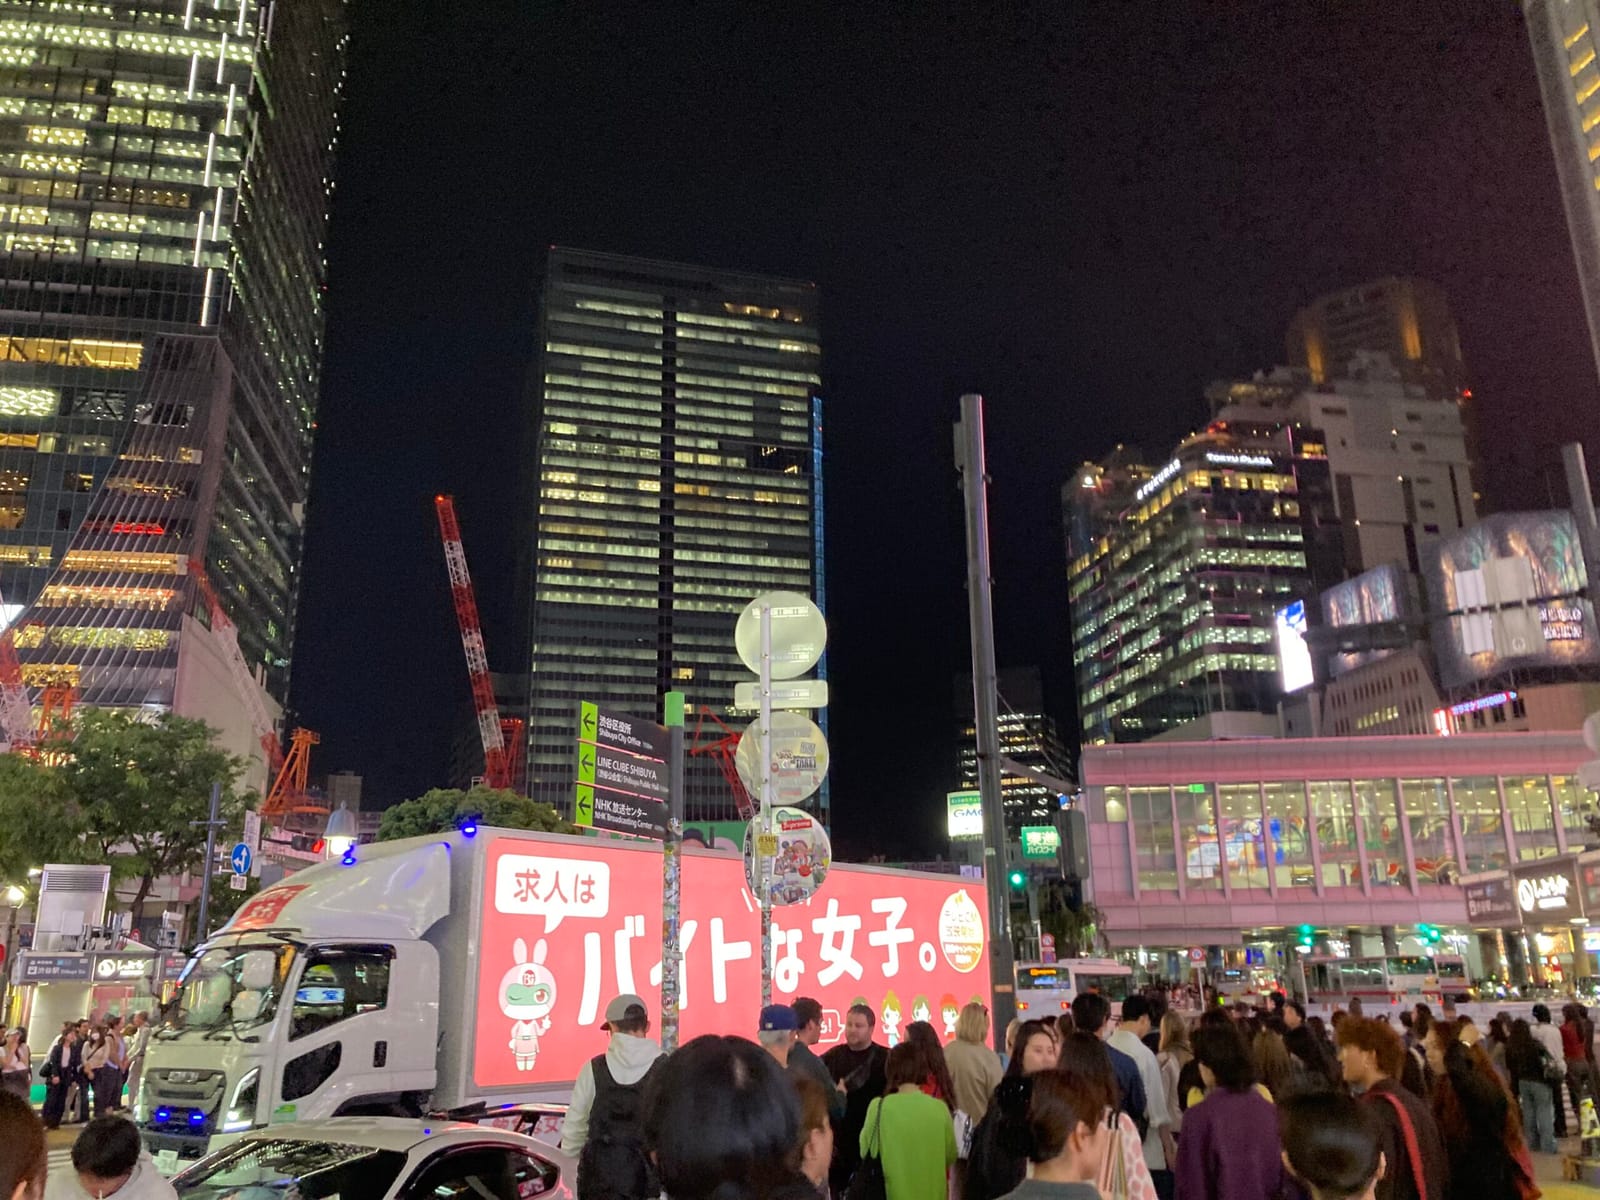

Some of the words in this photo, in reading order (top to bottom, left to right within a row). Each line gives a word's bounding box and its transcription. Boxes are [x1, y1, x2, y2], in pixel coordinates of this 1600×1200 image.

[1206, 453, 1239, 463] TOKYU
[1240, 455, 1274, 466] PLAZA
[599, 714, 632, 735] 渋谷区役所
[599, 727, 618, 741] Shibuya
[618, 733, 627, 744] City
[628, 736, 641, 747] Office
[597, 756, 612, 768] LINE
[612, 760, 630, 773] CUBE
[630, 764, 657, 780] SHIBUYA
[594, 811, 608, 820] NHK
[607, 813, 637, 829] Broadcasting
[637, 820, 653, 830] Center
[513, 868, 595, 904] 求人は
